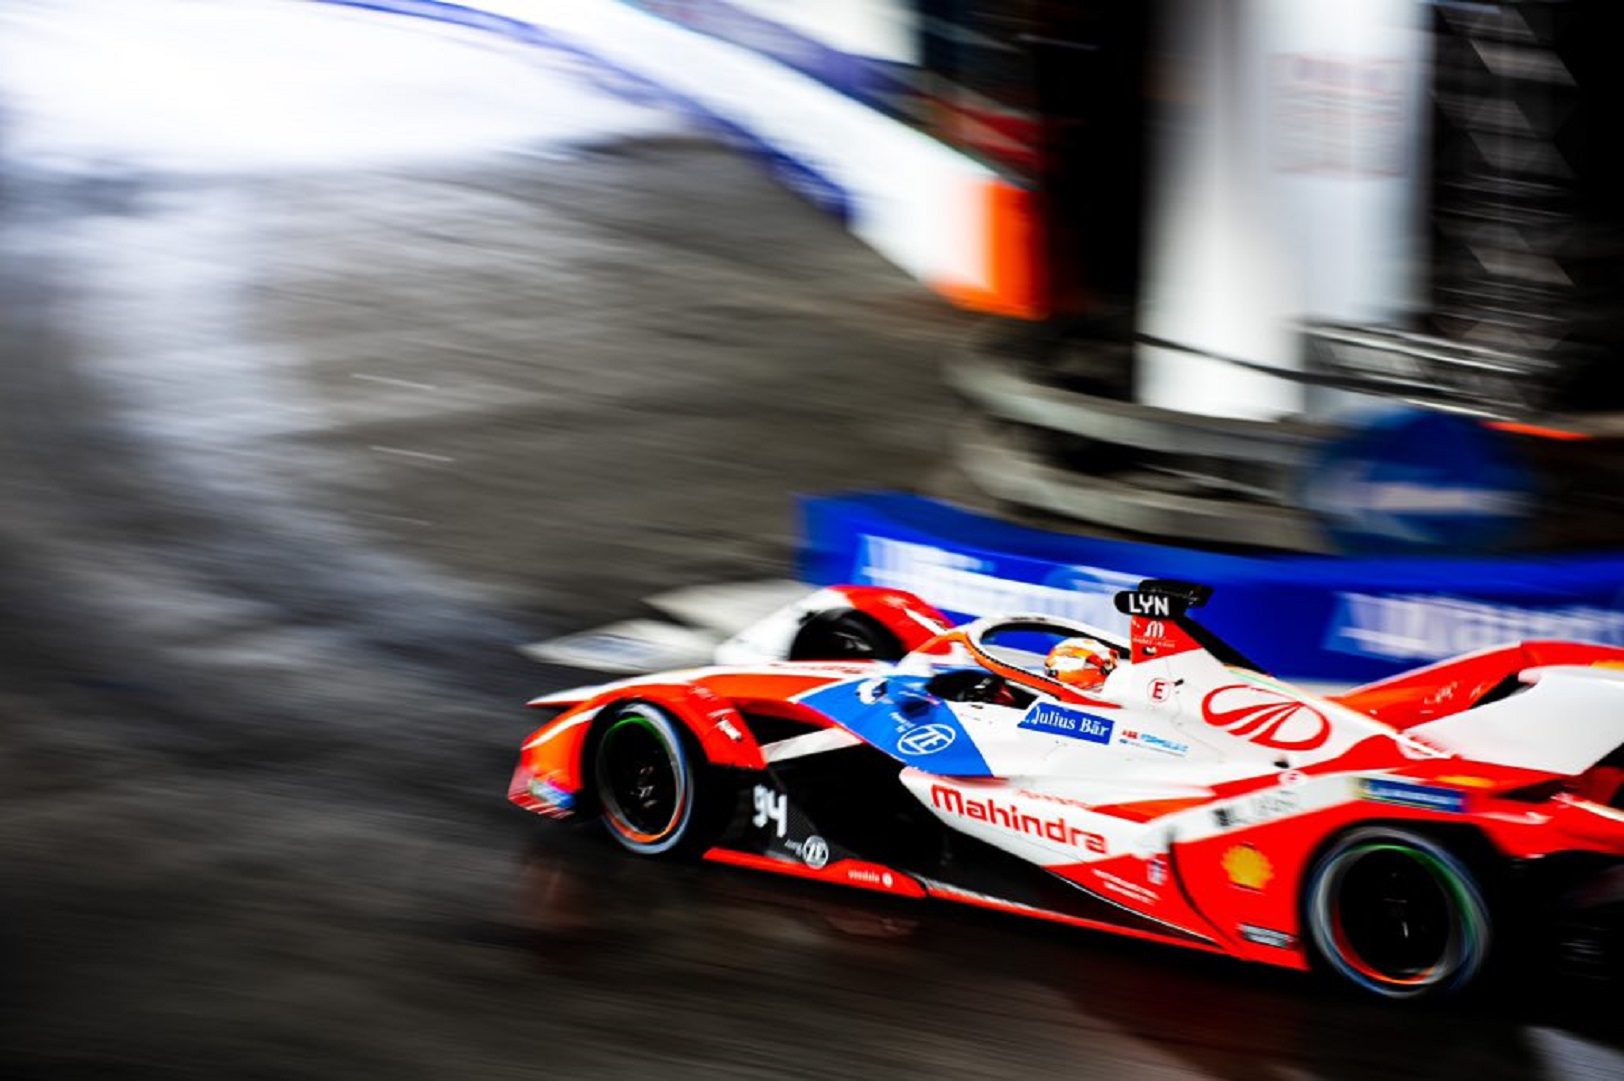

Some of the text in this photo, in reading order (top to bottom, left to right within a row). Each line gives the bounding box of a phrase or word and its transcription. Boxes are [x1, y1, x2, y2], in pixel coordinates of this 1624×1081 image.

[1129, 593, 1170, 617] LYN
[1025, 706, 1110, 738] Julius Bär
[752, 784, 788, 838] 94
[930, 784, 1107, 855] Mahindra
